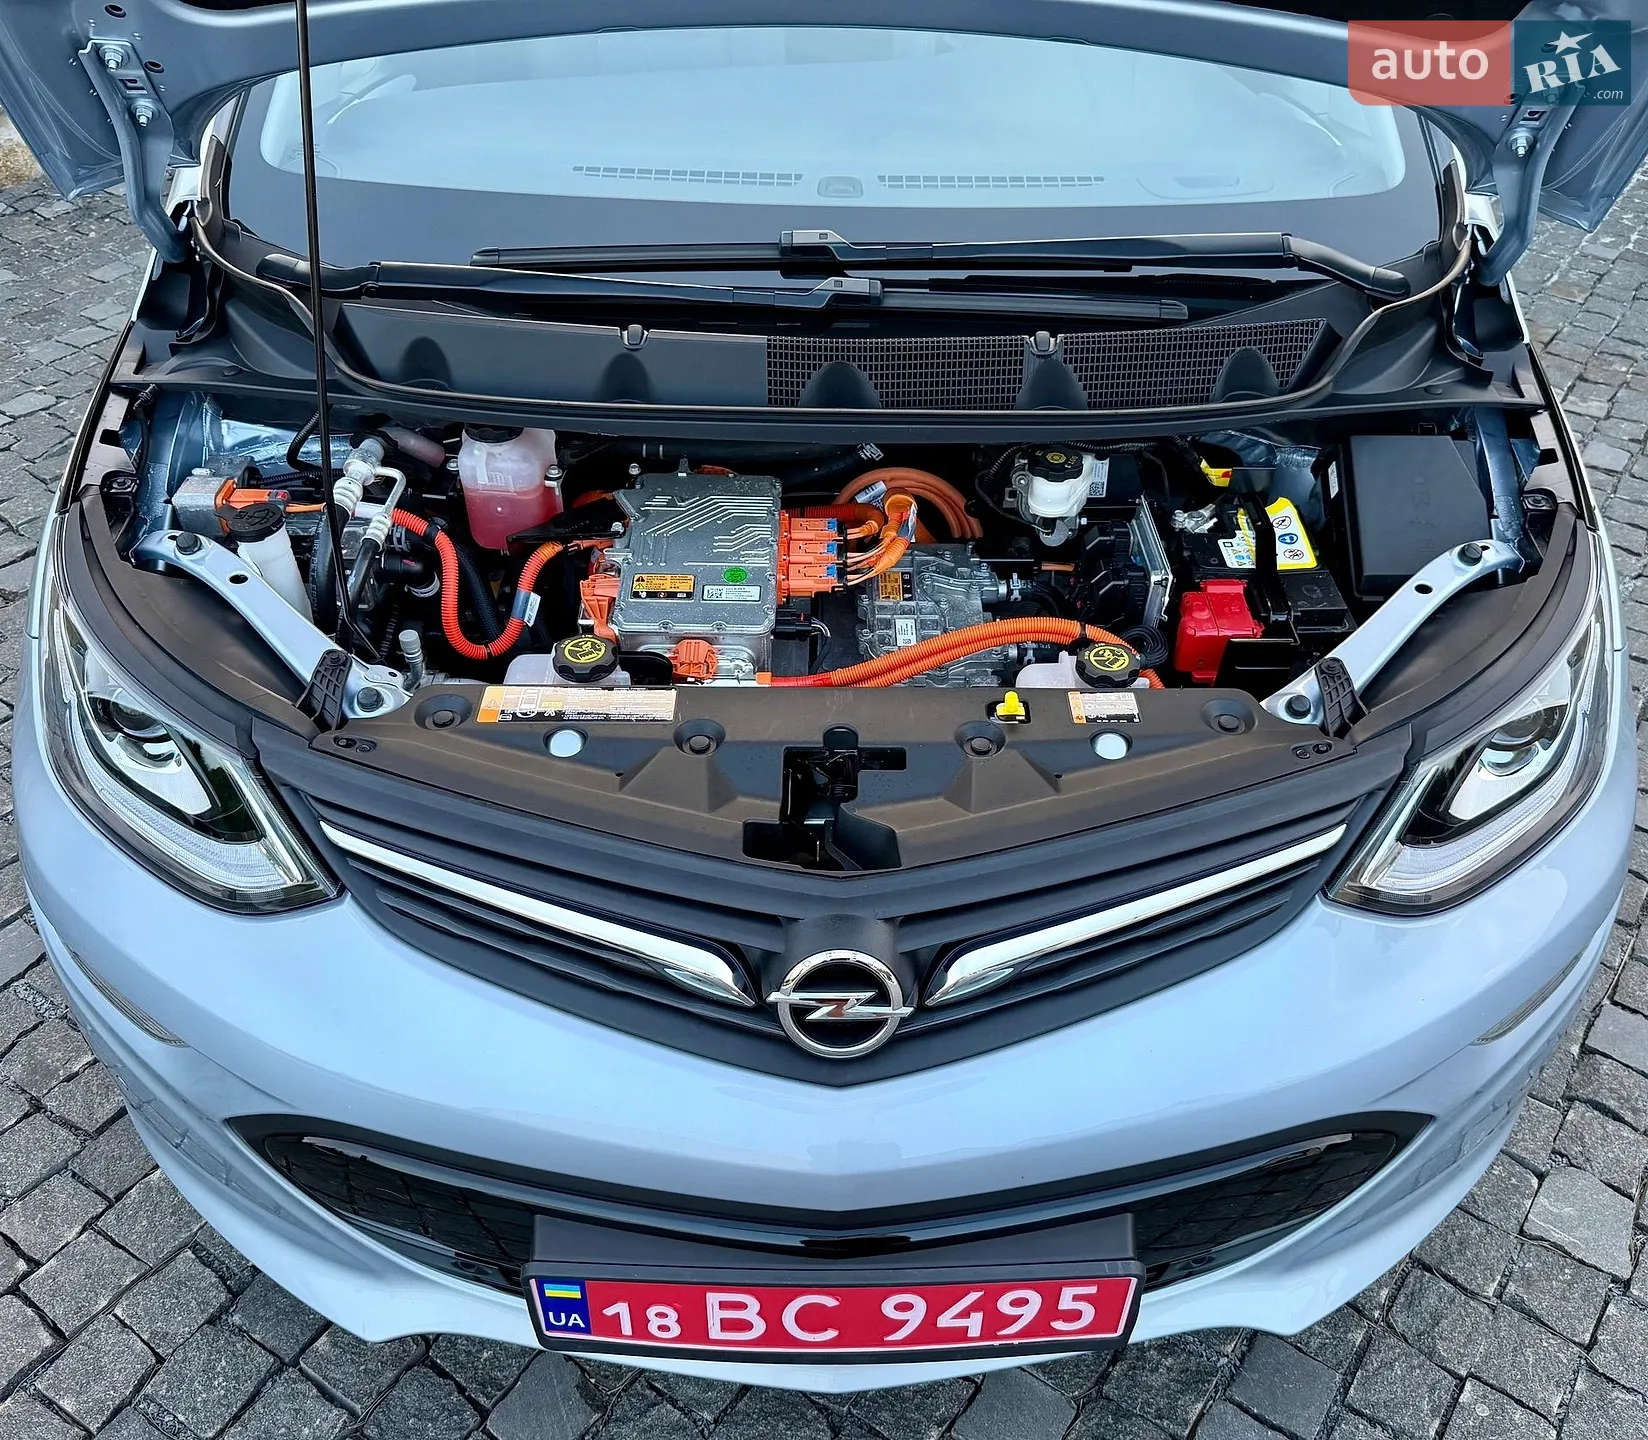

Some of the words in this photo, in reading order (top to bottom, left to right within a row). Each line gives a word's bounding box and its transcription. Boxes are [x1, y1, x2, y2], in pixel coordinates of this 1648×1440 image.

[548, 1311, 585, 1328] UA
[602, 1302, 682, 1339] 18
[706, 1291, 841, 1342] BC
[881, 1284, 1098, 1341] 9495
